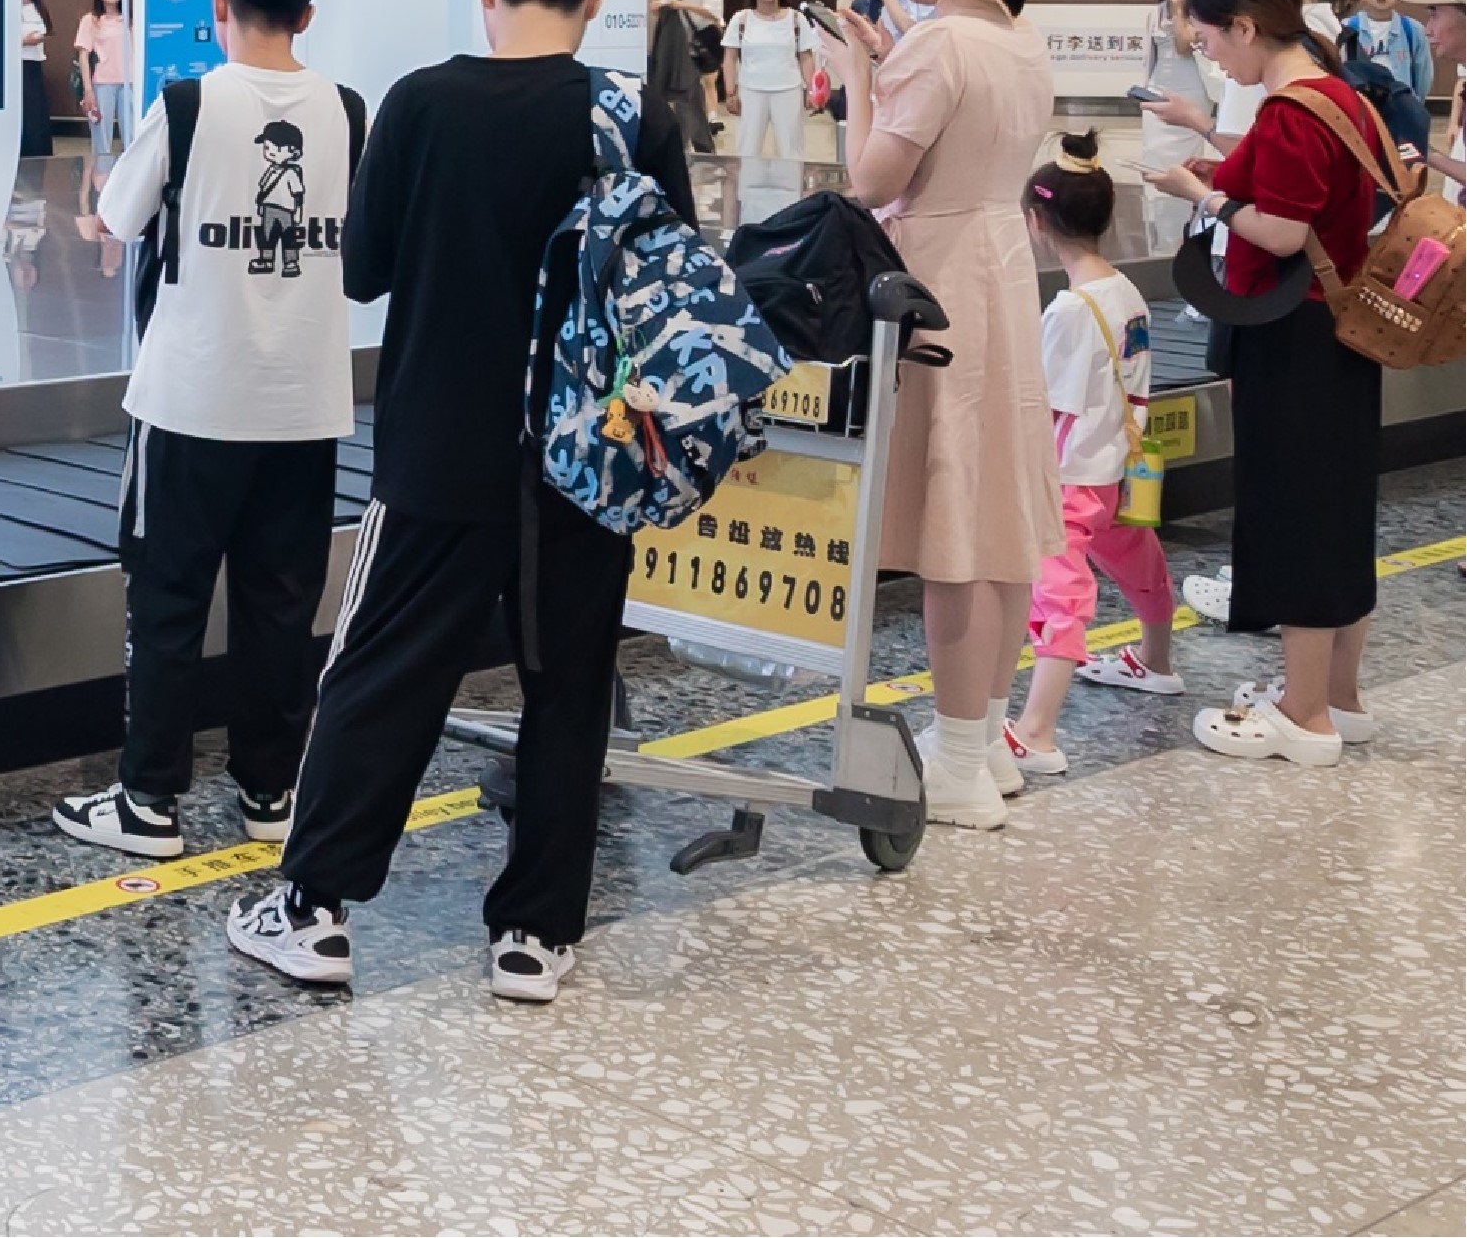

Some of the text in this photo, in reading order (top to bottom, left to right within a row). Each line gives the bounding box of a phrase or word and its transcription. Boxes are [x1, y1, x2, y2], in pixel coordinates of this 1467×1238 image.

[1047, 33, 1144, 52] 行李送到家
[198, 214, 345, 251] olivett
